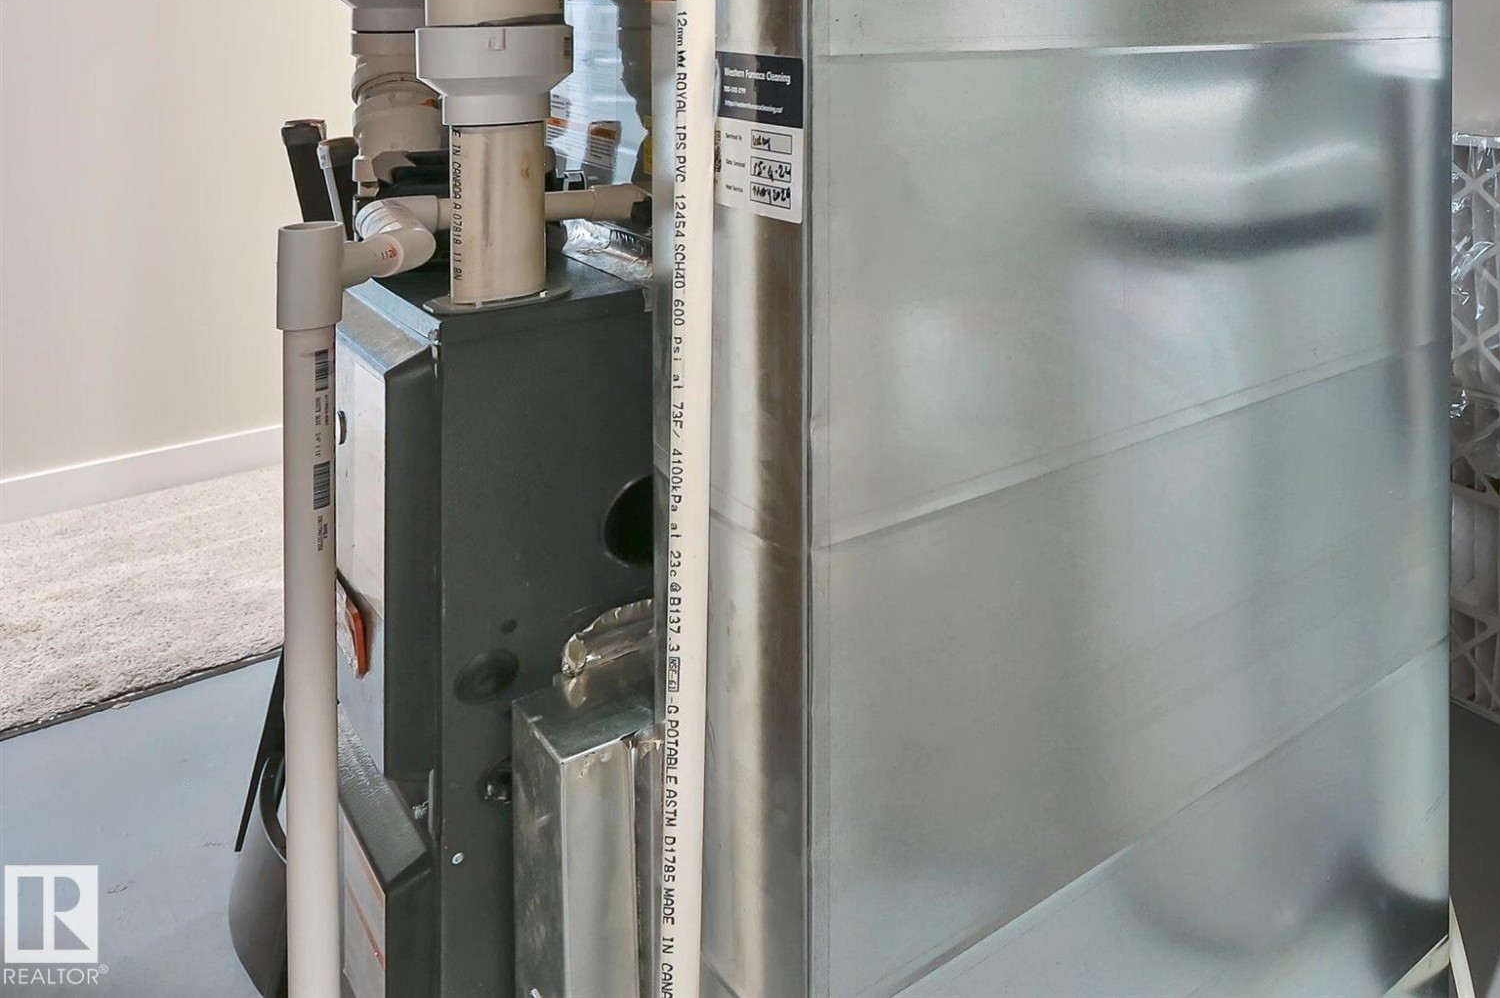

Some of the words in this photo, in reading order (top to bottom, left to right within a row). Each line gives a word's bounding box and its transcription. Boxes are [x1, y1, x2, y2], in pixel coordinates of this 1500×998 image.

[677, 11, 688, 47] 12mm
[676, 73, 687, 119] ROYAL
[452, 144, 461, 156] IN
[676, 125, 687, 150] IPS
[452, 161, 462, 199] CANADA
[675, 154, 687, 183] PVC
[674, 194, 687, 238] 12454
[674, 243, 686, 289] SCH40
[673, 299, 685, 326] 600
[672, 374, 682, 390] at
[672, 402, 684, 438] 73F/
[670, 448, 682, 512] 4100kPa
[670, 522, 682, 538] at
[668, 597, 681, 652] B137.3
[668, 657, 680, 692] NSF-61
[665, 719, 678, 785] POTABLE
[665, 789, 677, 827] ASTM
[664, 836, 676, 882] D1785
[663, 888, 675, 925] MADE
[662, 937, 674, 954] IN
